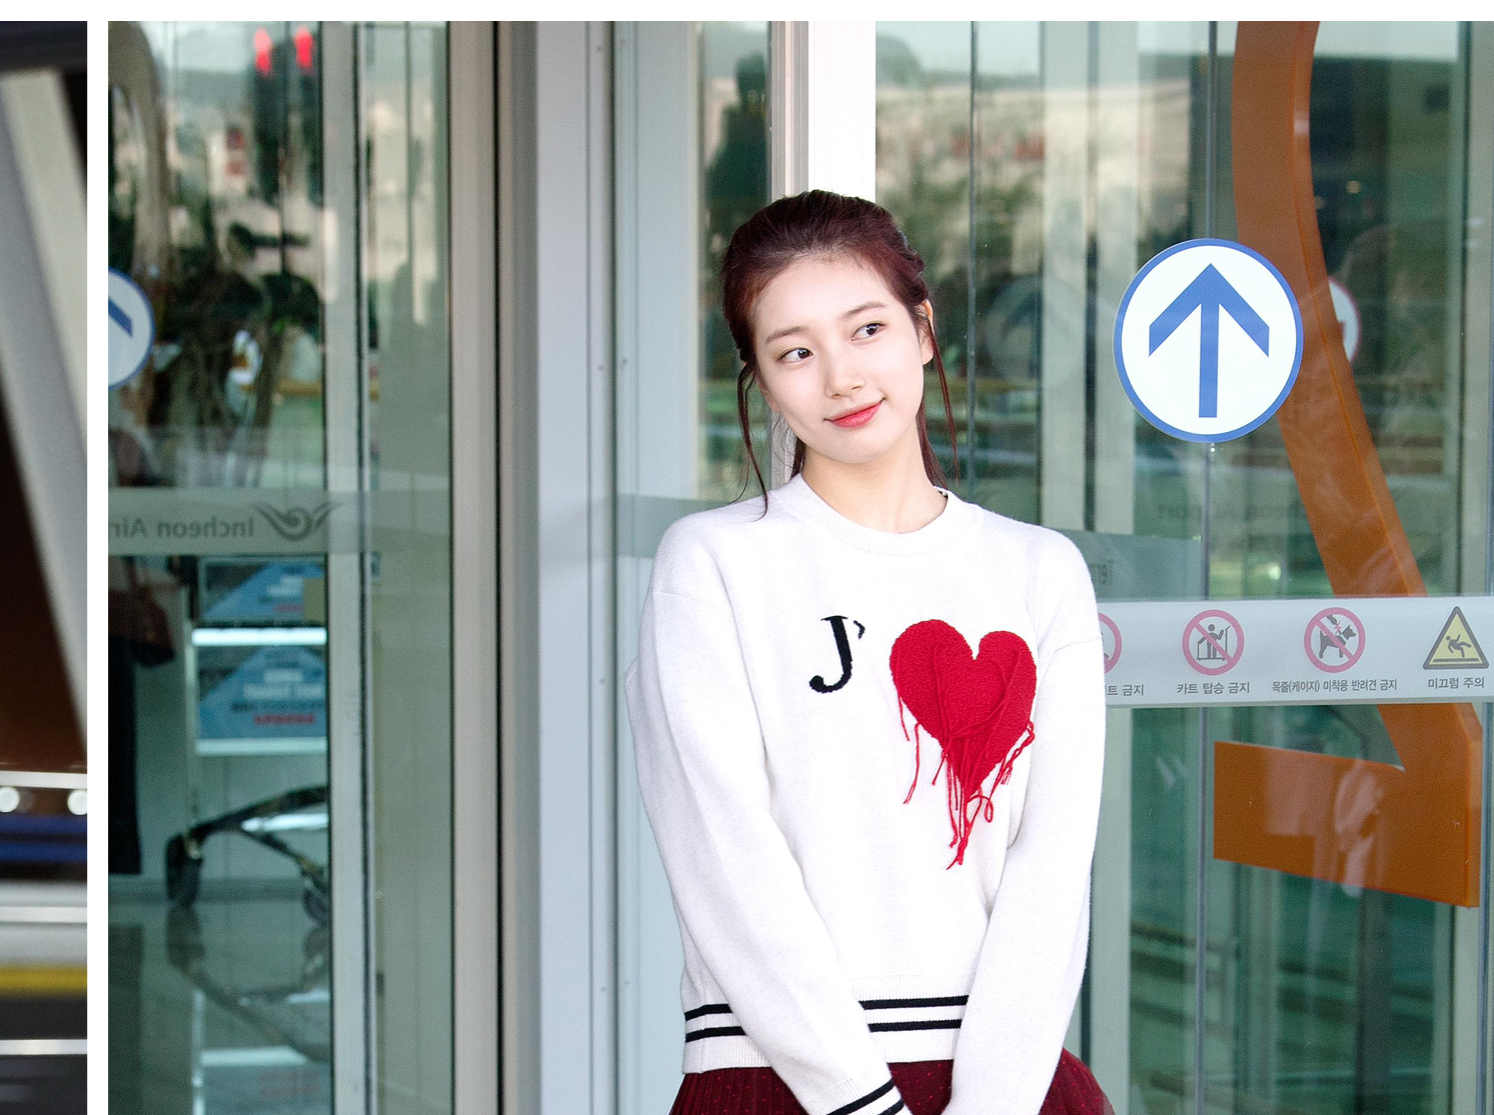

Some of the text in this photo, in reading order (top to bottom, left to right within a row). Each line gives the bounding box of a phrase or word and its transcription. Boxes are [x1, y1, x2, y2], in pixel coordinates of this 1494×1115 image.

[1177, 681, 1250, 695] 카트 탑승 금지
[1323, 679, 1348, 692] 미착용
[1351, 679, 1377, 692] 반려견
[1380, 679, 1397, 691] 금지
[1427, 676, 1485, 690] 미끄럼 주의
[1105, 684, 1144, 696] 트 금지
